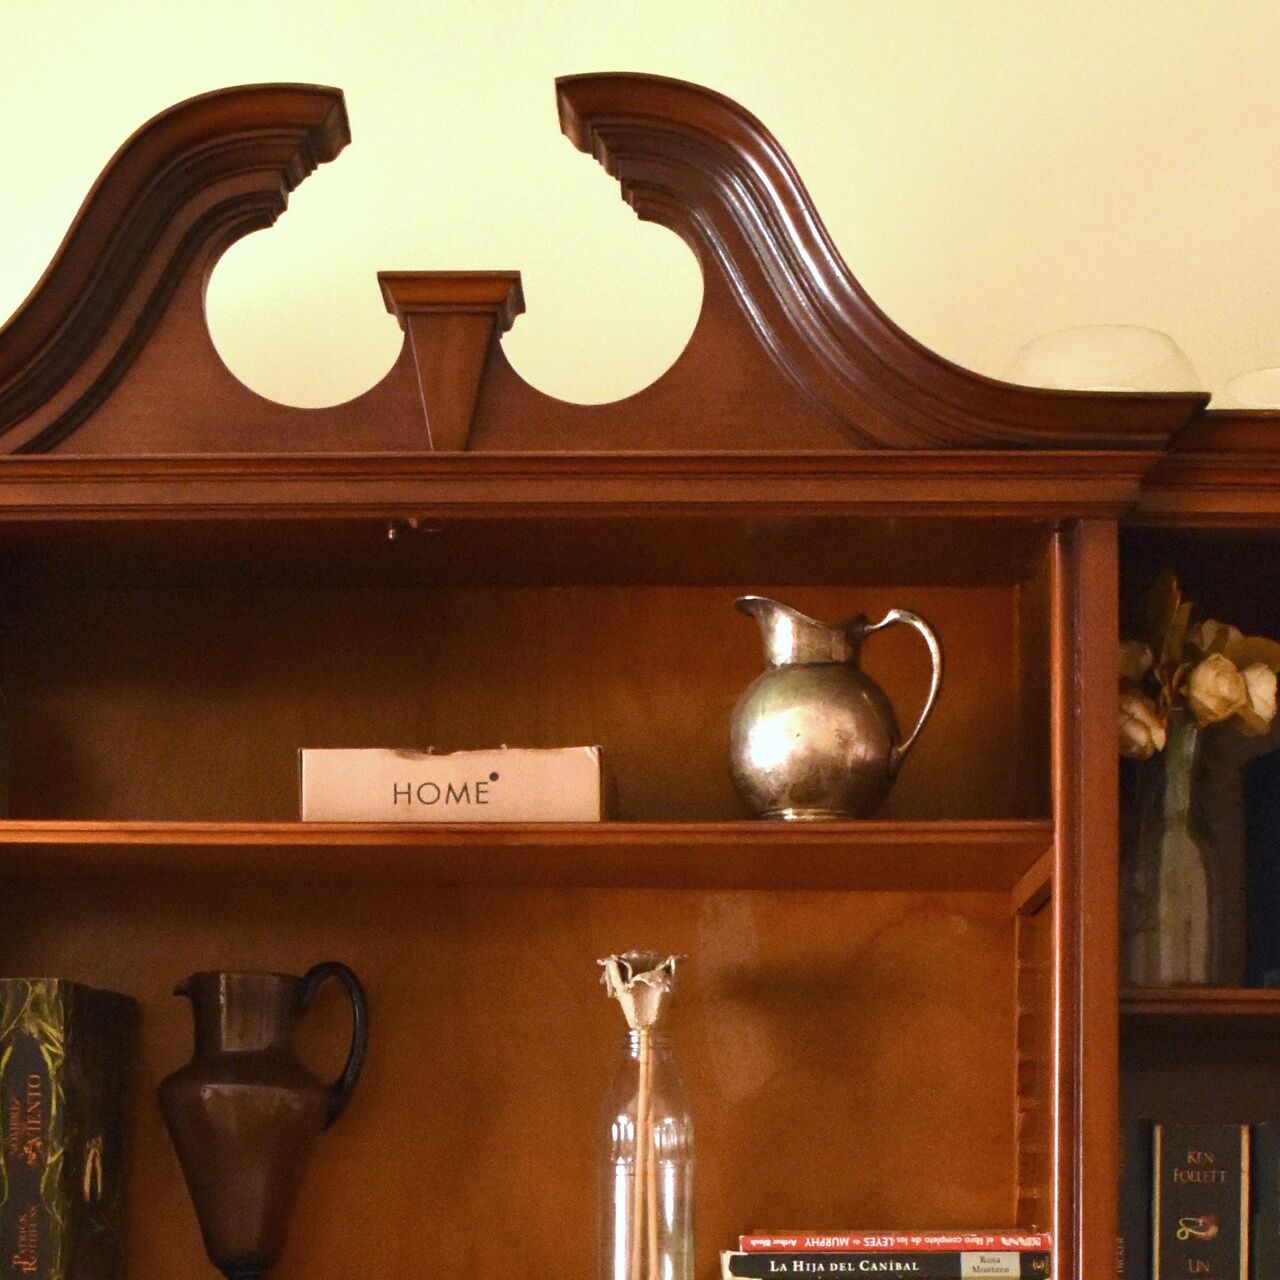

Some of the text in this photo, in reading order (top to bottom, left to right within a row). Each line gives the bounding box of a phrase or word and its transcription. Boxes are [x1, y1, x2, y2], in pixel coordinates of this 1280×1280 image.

[393, 782, 489, 804] HOME
[1187, 1152, 1215, 1163] KEN
[1173, 1168, 1227, 1183] FOLLETT
[804, 1236, 850, 1248] MURPHY
[863, 1236, 894, 1248] LEYES
[924, 1235, 963, 1246] completo
[979, 1255, 1001, 1265] Rosa
[1188, 1259, 1210, 1272] UN
